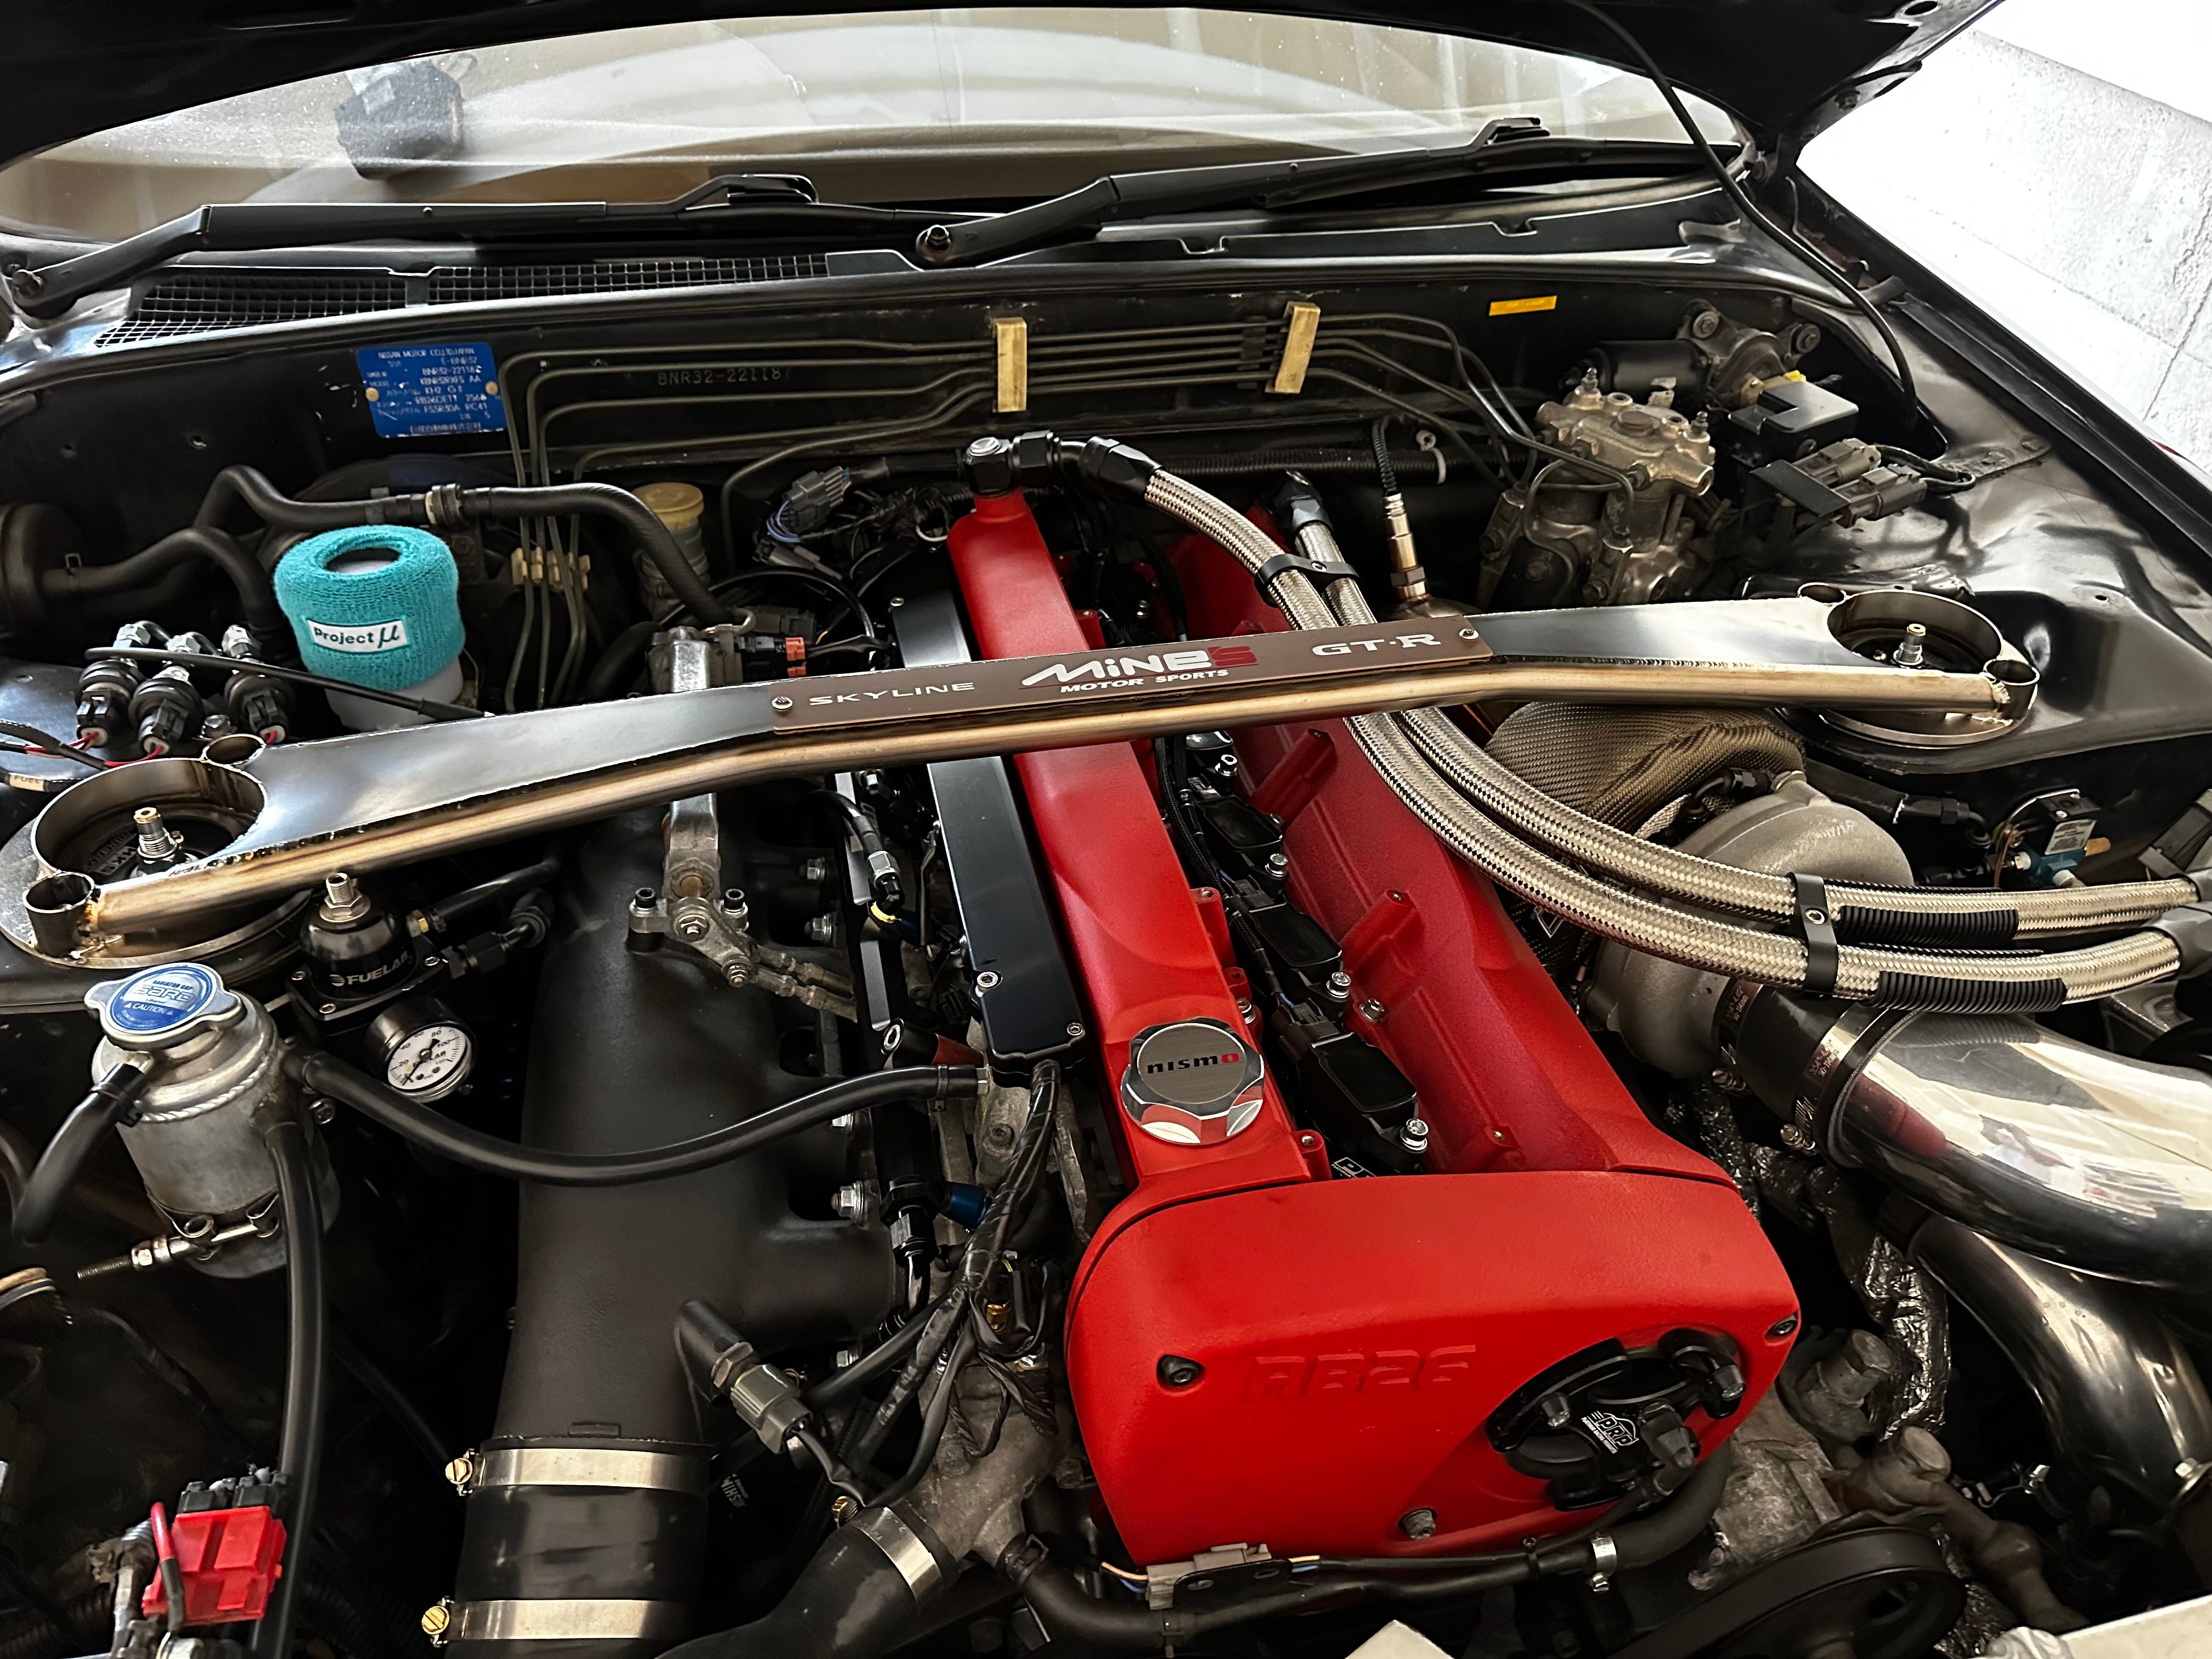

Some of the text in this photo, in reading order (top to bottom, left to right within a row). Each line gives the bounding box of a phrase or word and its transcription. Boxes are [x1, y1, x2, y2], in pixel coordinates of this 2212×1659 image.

[314, 627, 374, 645] Project
[1060, 669, 1229, 693] MOTOR SPORTS
[809, 682, 975, 706] SKYLINE
[14, 775, 40, 784] FUEL
[346, 950, 408, 985] FUELAB
[132, 1003, 166, 1014] CAUTION
[1147, 1053, 1239, 1074] nismo
[1243, 1344, 1476, 1400] RB26
